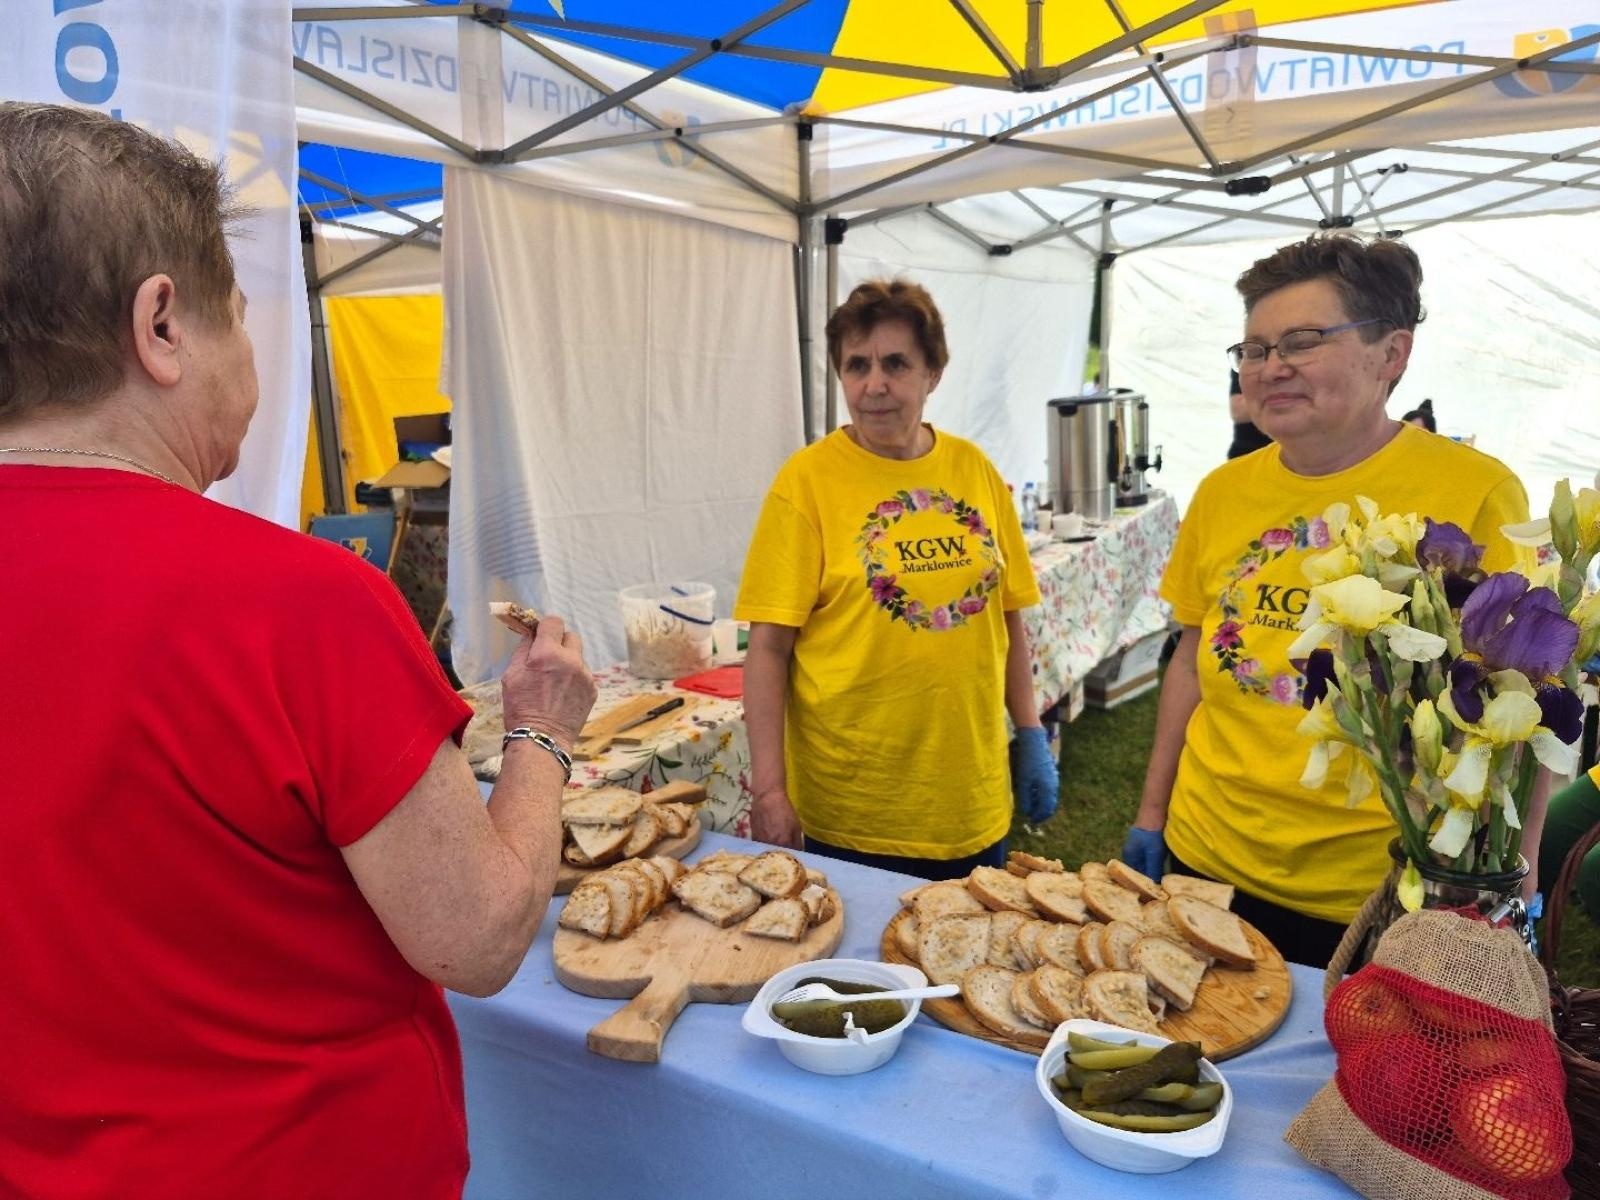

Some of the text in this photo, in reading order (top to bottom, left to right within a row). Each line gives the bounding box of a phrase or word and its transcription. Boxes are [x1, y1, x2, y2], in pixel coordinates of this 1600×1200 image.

[895, 535, 966, 561] KGW
[899, 558, 972, 574] Marklowice
[1254, 584, 1311, 615] KG
